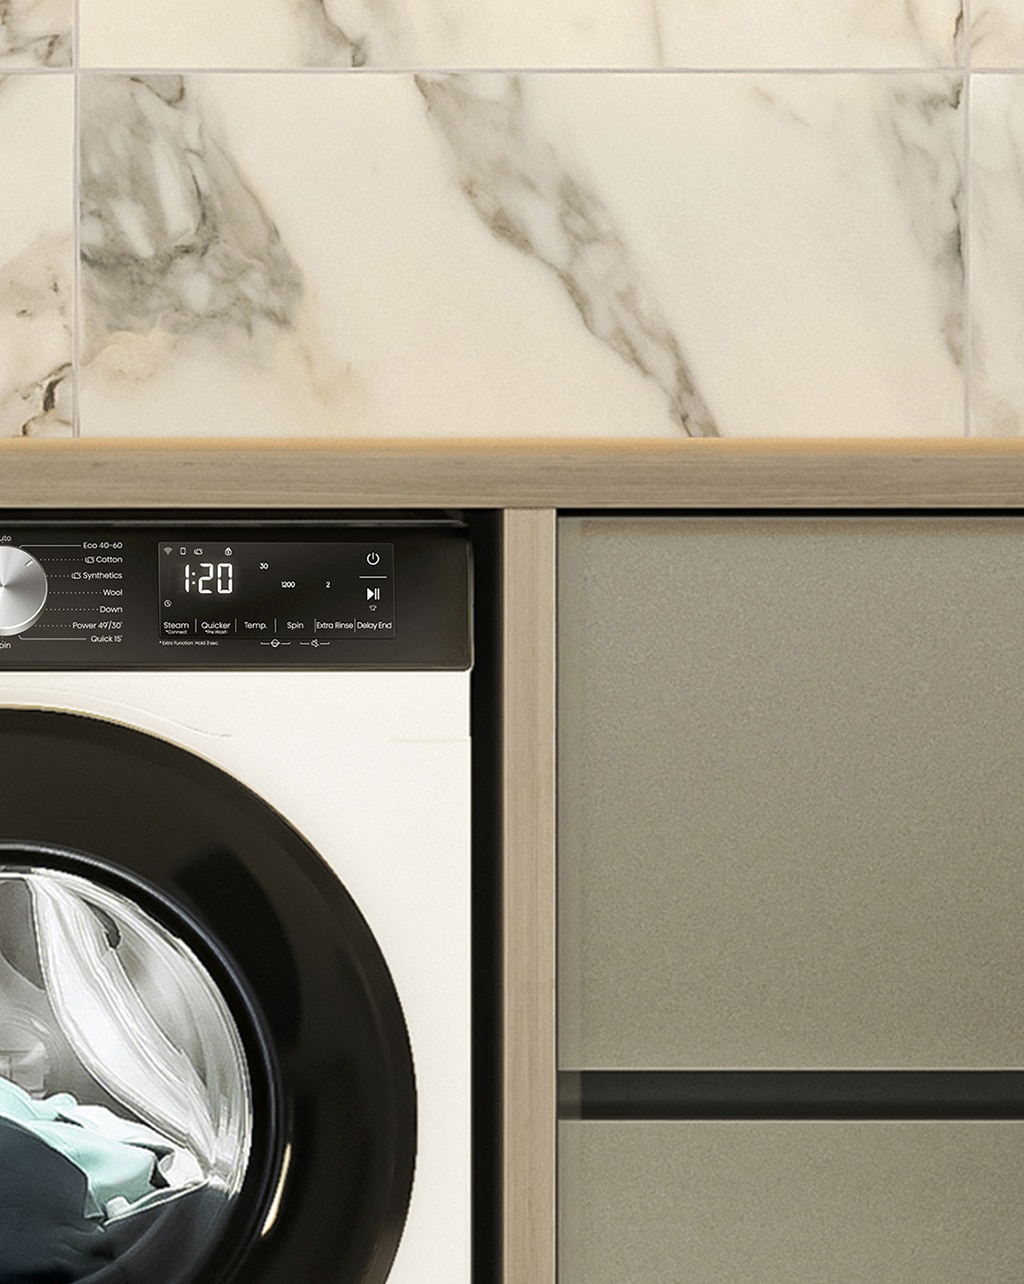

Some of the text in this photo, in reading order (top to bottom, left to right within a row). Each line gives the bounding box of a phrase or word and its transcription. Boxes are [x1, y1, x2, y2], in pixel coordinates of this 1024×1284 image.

[83, 541, 123, 549] Eco 40-60
[96, 555, 123, 563] Cotton
[259, 562, 269, 570] 30
[83, 572, 123, 581] Synthetics
[184, 563, 233, 594] 1:20
[102, 588, 123, 597] Wool
[72, 621, 97, 629] Power
[163, 621, 190, 629] Steam
[201, 621, 231, 629] Quicker
[244, 621, 267, 630] Temp.
[286, 621, 303, 630] Spin
[316, 621, 353, 629] Extra Rinse
[357, 621, 392, 630] Delay End
